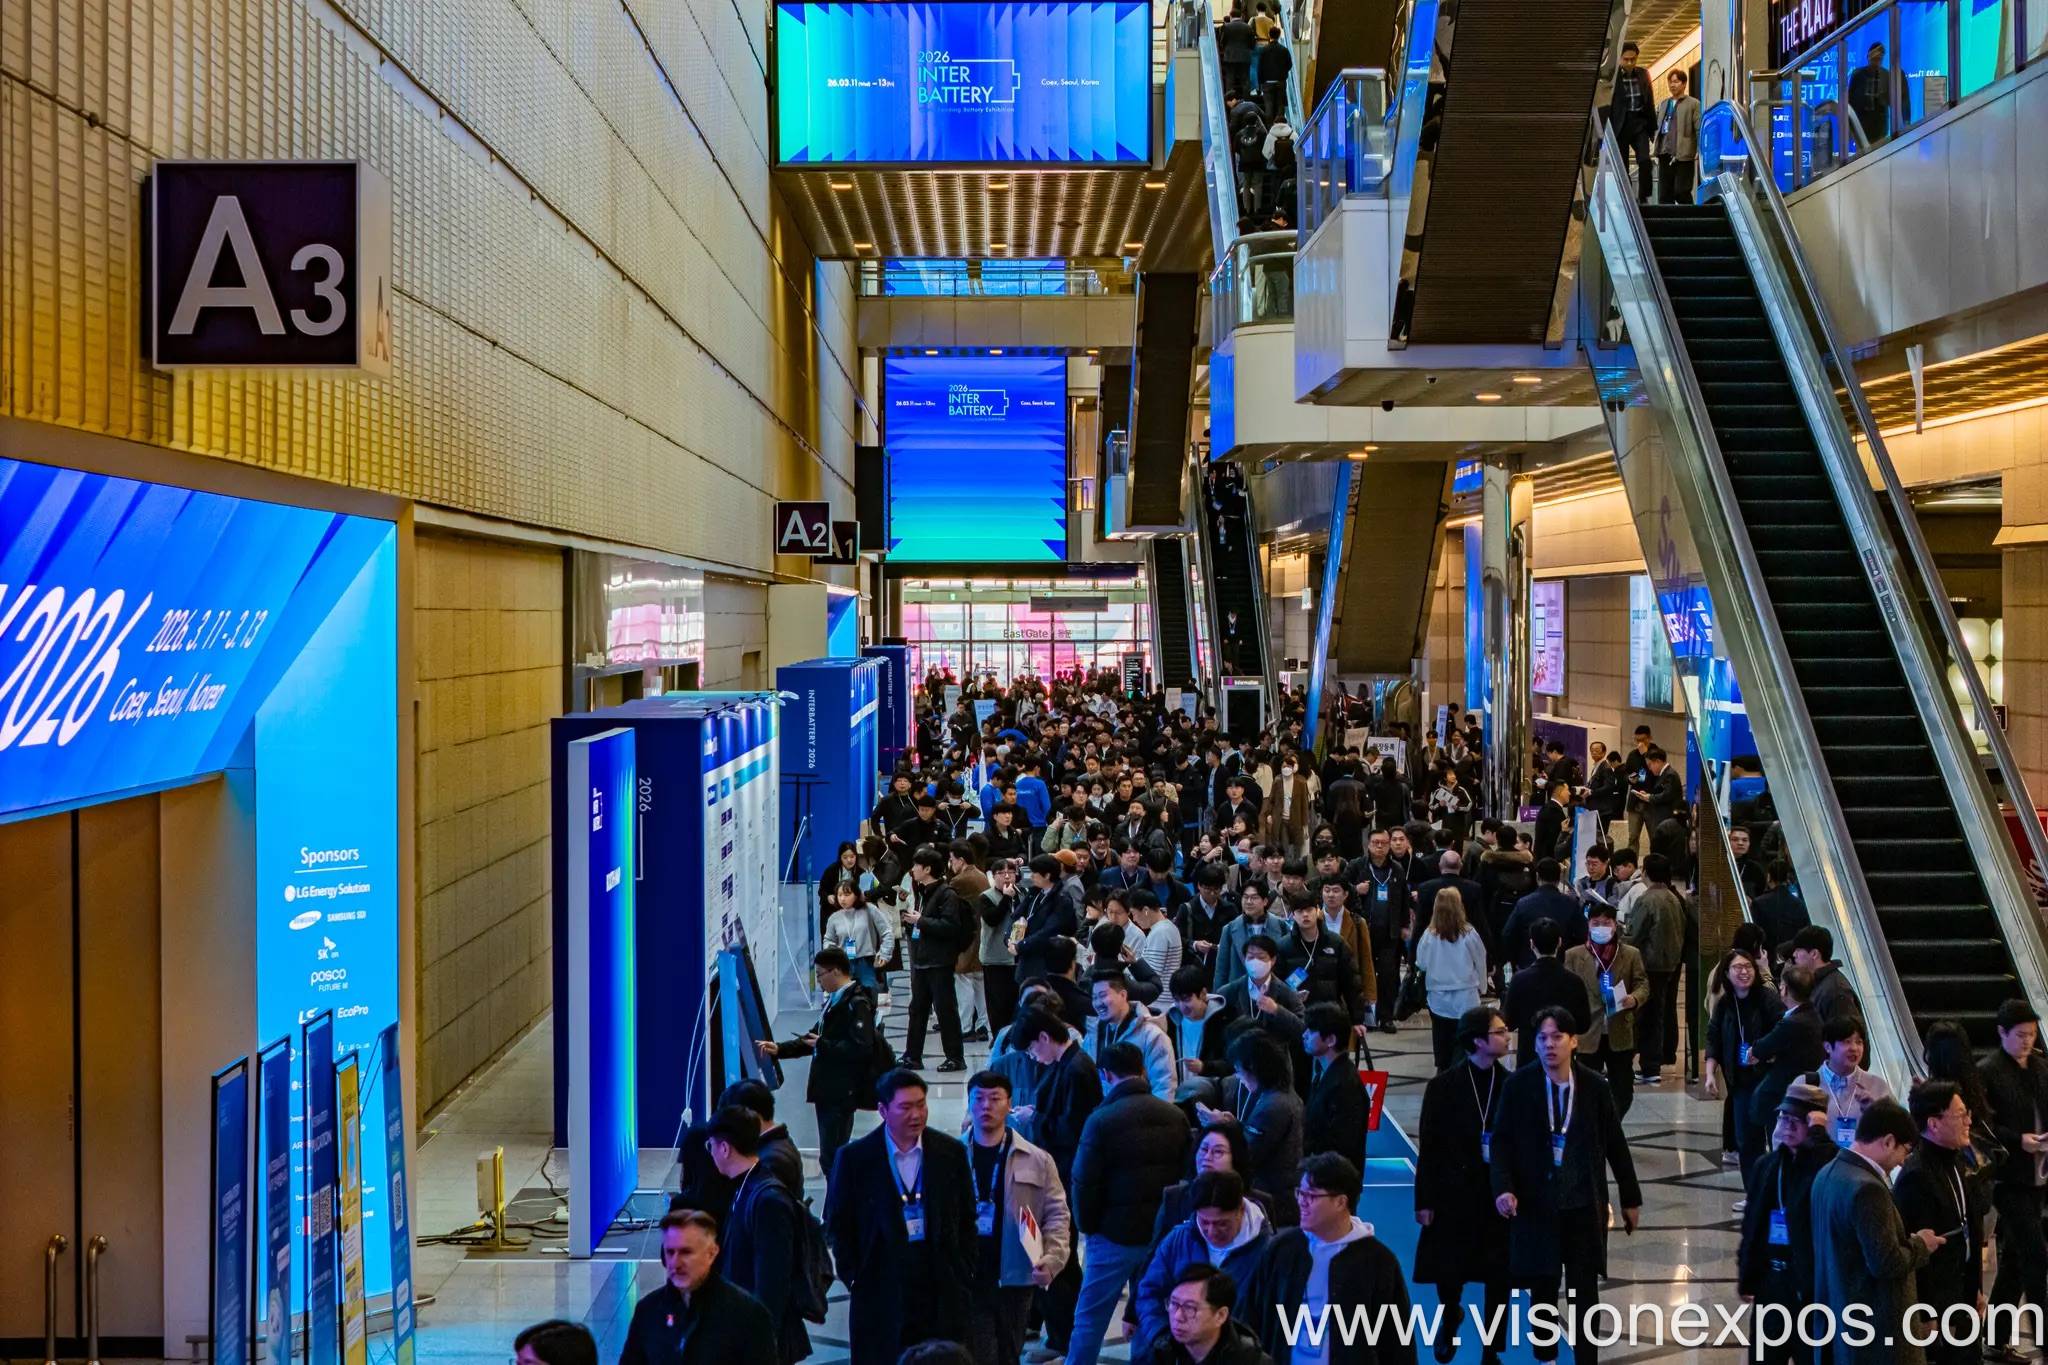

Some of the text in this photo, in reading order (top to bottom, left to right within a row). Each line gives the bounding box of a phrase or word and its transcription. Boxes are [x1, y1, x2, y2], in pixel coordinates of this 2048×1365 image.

[1780, 7, 1799, 54] THE
[918, 51, 950, 63] 2026
[918, 66, 971, 83] INTER
[918, 86, 994, 103] BATTERY
[167, 195, 347, 336] A3
[948, 384, 968, 392] 2026
[948, 393, 980, 404] INTER
[948, 405, 993, 416] BATTERY
[780, 510, 827, 547] A2
[185, 673, 226, 712] Korea
[808, 689, 816, 769] INTERBATTERY 2026
[639, 777, 652, 812] 2026
[301, 847, 360, 868] Sponsors
[297, 883, 370, 899] LG Energy Solution
[327, 911, 356, 922] SAMSUNG
[318, 949, 329, 960] SK
[319, 983, 342, 992] FUTURE
[337, 1005, 368, 1019] EcoPro
